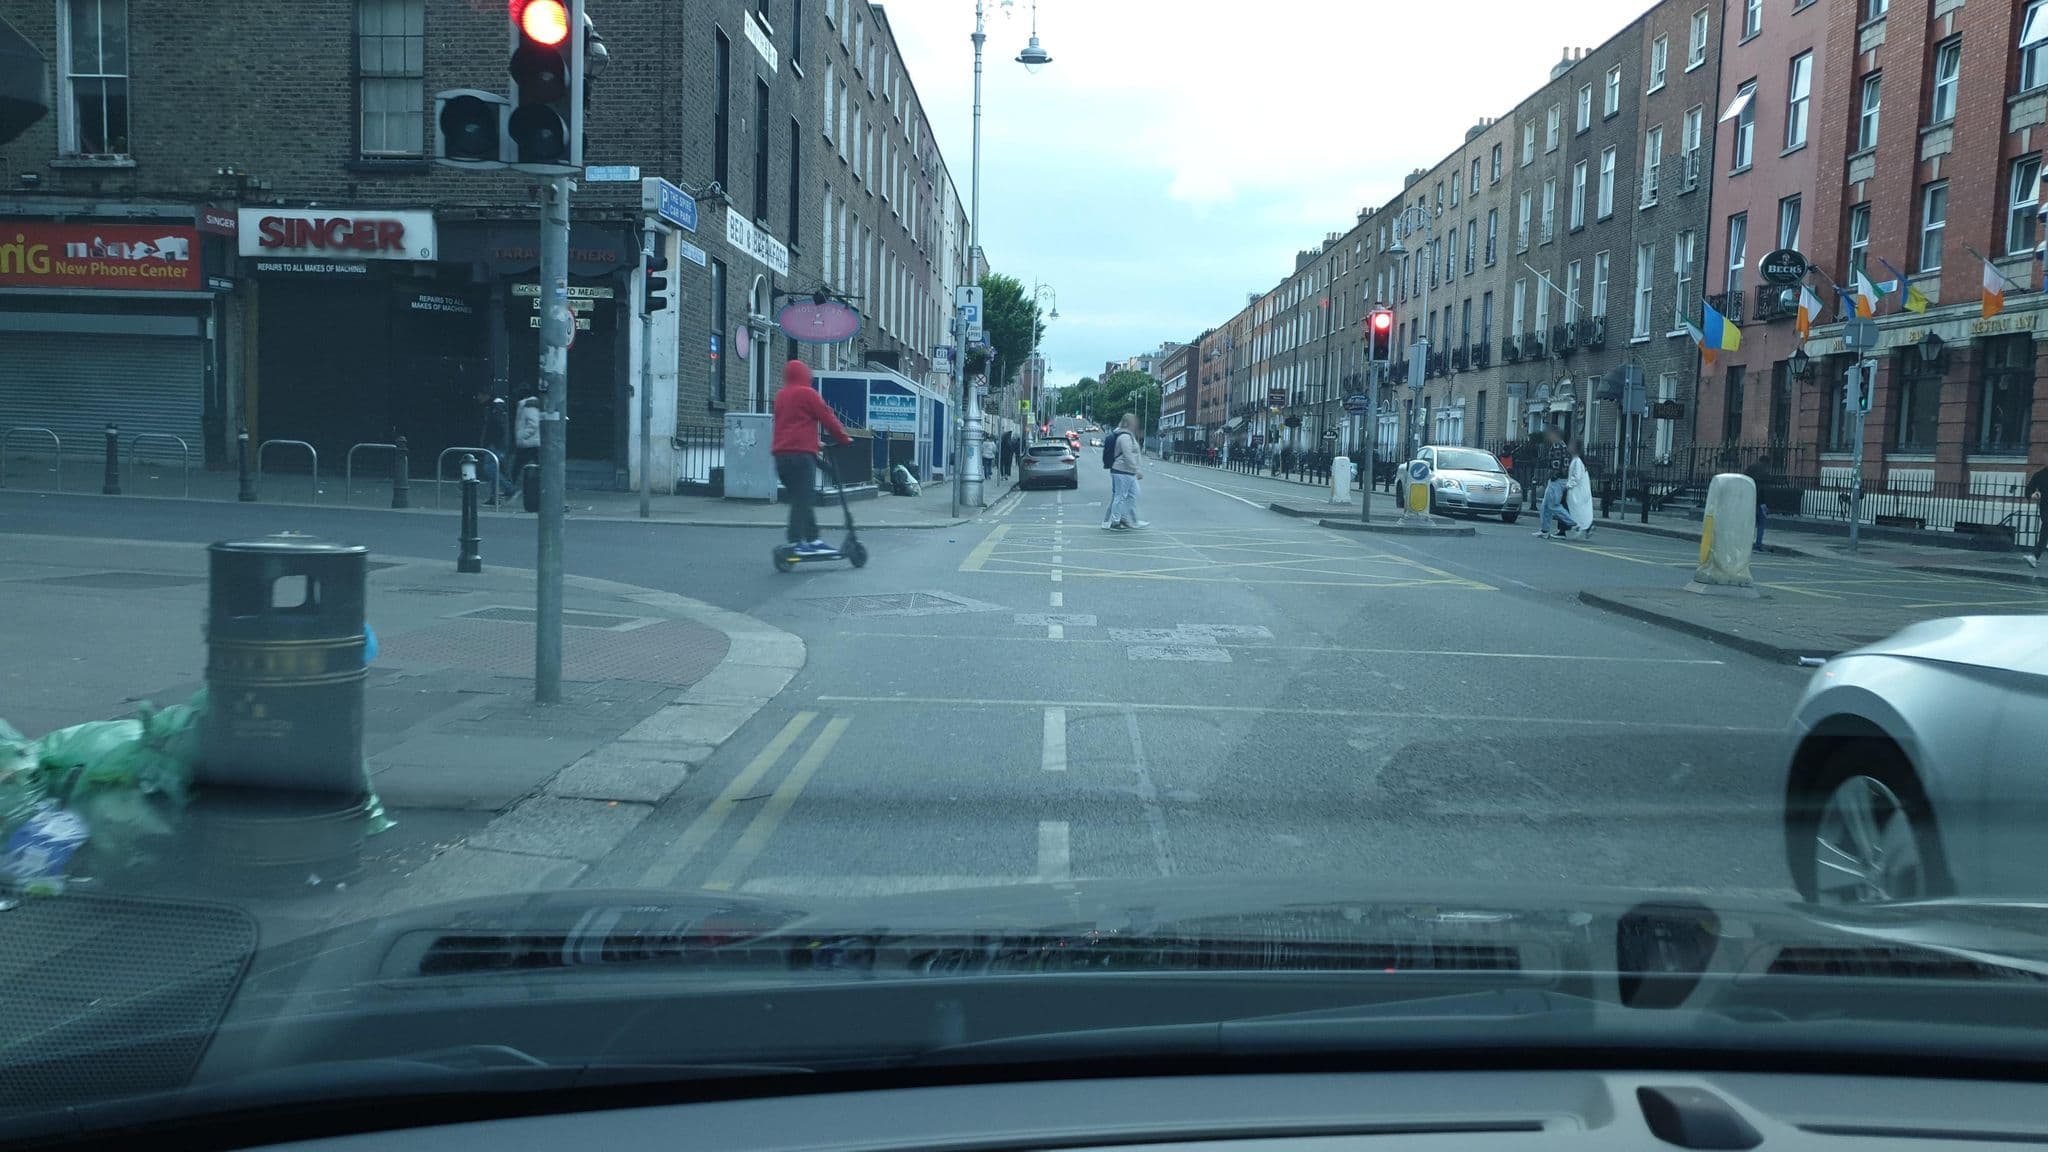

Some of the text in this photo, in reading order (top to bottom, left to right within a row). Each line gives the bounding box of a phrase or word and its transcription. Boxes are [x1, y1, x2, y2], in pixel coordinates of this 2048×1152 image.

[206, 214, 235, 229] SINGER
[670, 205, 691, 224] CAR PARK
[258, 216, 406, 250] SINGER
[730, 214, 744, 245] BED
[753, 231, 787, 271] BREAKFAST
[56, 261, 188, 278] New Phone Center
[257, 263, 366, 273] REPAIRS TO ALL MAKES OF MACHINES
[411, 302, 432, 310] MAKES
[419, 295, 444, 304] REPAIRS
[445, 297, 454, 305] TO
[966, 308, 975, 320] P
